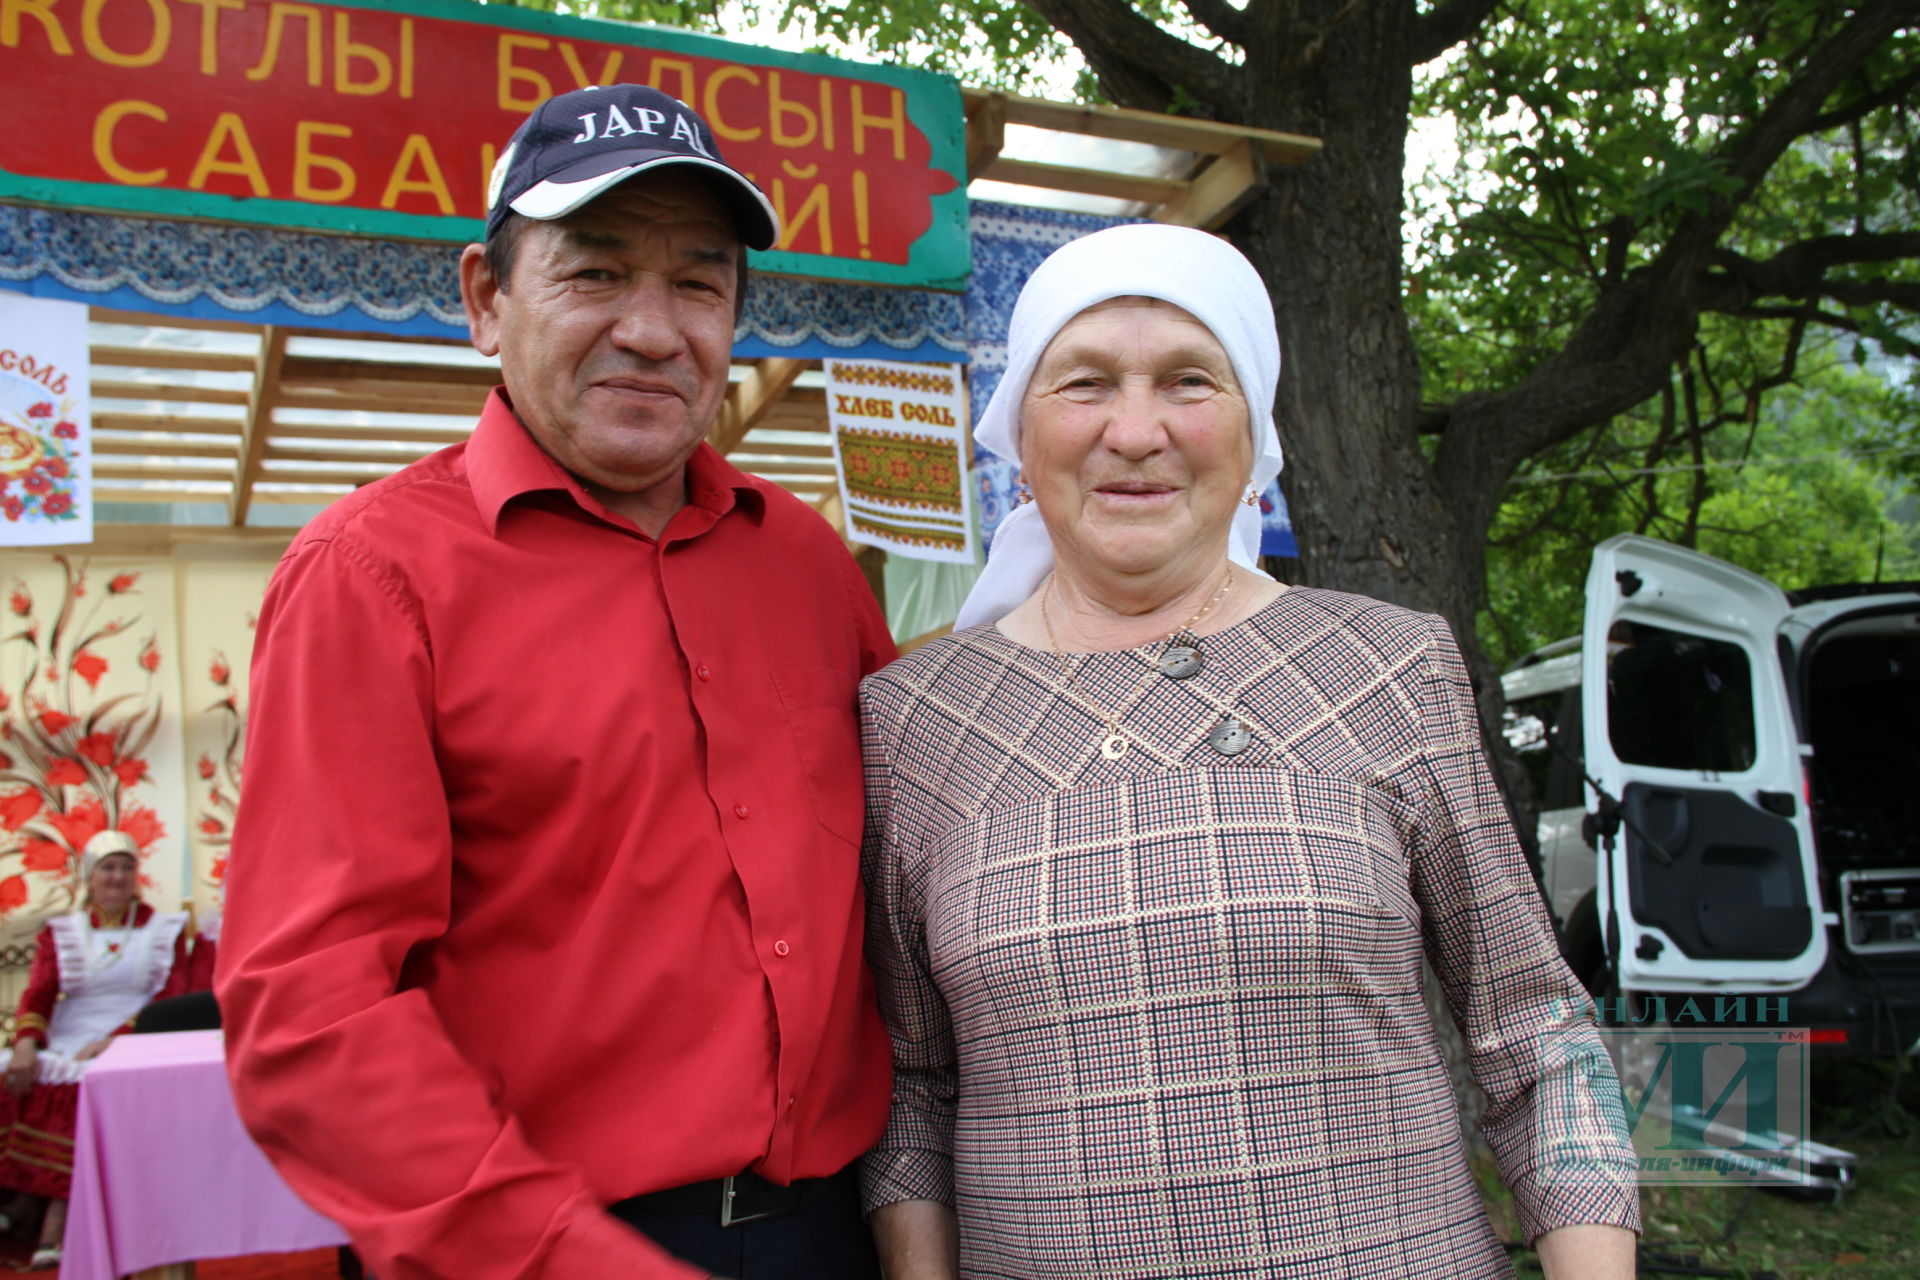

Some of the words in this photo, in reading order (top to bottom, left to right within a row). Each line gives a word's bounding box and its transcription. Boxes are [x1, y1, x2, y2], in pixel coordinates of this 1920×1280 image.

[0, 0, 414, 98] КОТЛЫ
[93, 99, 871, 259] САБАЙ!
[0, 349, 70, 395] СОЛЬ
[834, 393, 894, 419] ХЛЕБ
[899, 401, 957, 428] СОЛЬ
